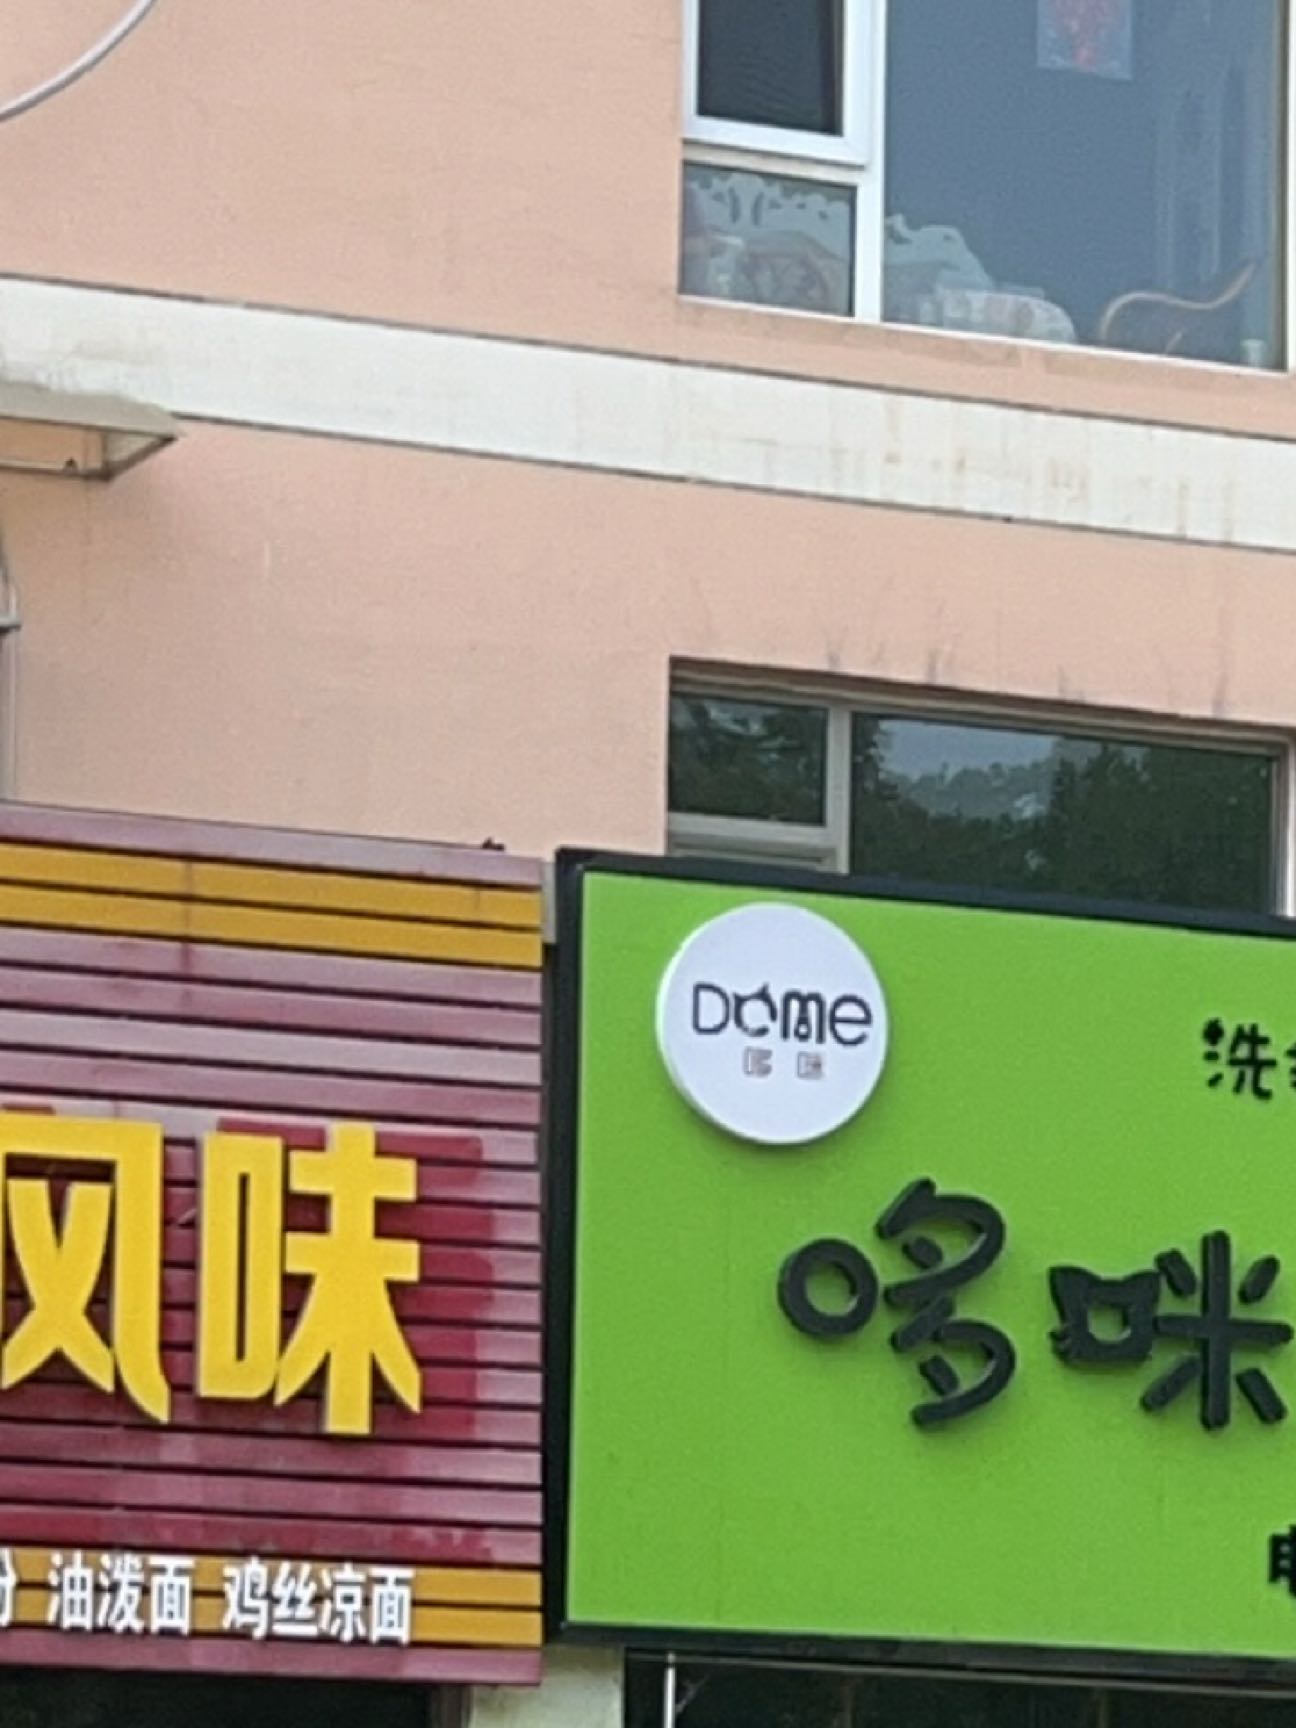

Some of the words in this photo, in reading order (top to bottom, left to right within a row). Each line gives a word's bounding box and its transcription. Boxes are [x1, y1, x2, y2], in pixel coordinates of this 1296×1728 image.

[0, 1112, 422, 1436] 风味
[47, 1550, 196, 1635] 油泼面
[222, 1556, 416, 1645] 鸡丝凉面
